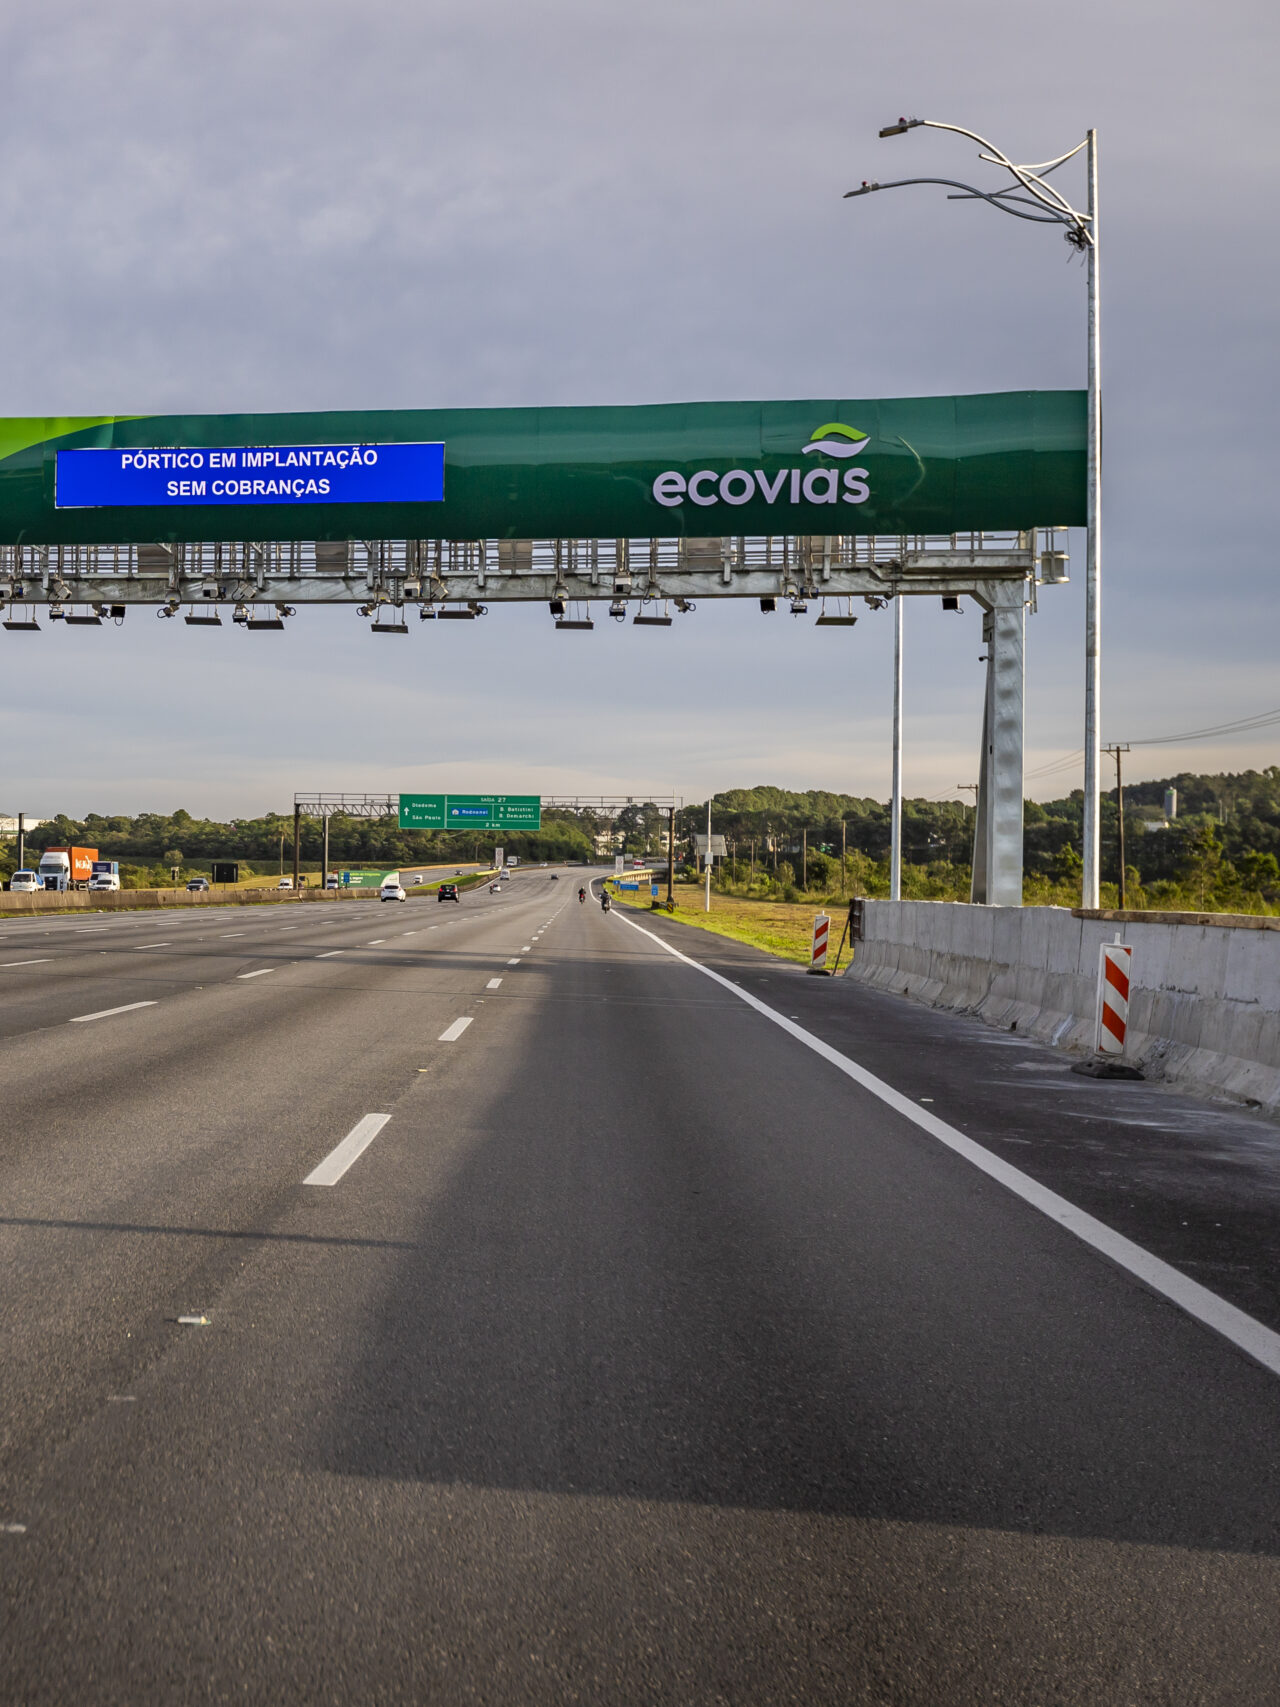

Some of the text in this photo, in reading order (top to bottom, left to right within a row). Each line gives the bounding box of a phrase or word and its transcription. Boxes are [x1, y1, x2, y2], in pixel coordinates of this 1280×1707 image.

[121, 448, 378, 470] PÓRTICO EM IMPLANTAÇÃO
[166, 478, 331, 498] SEM COBRANÇAS
[652, 467, 870, 507] ecovias
